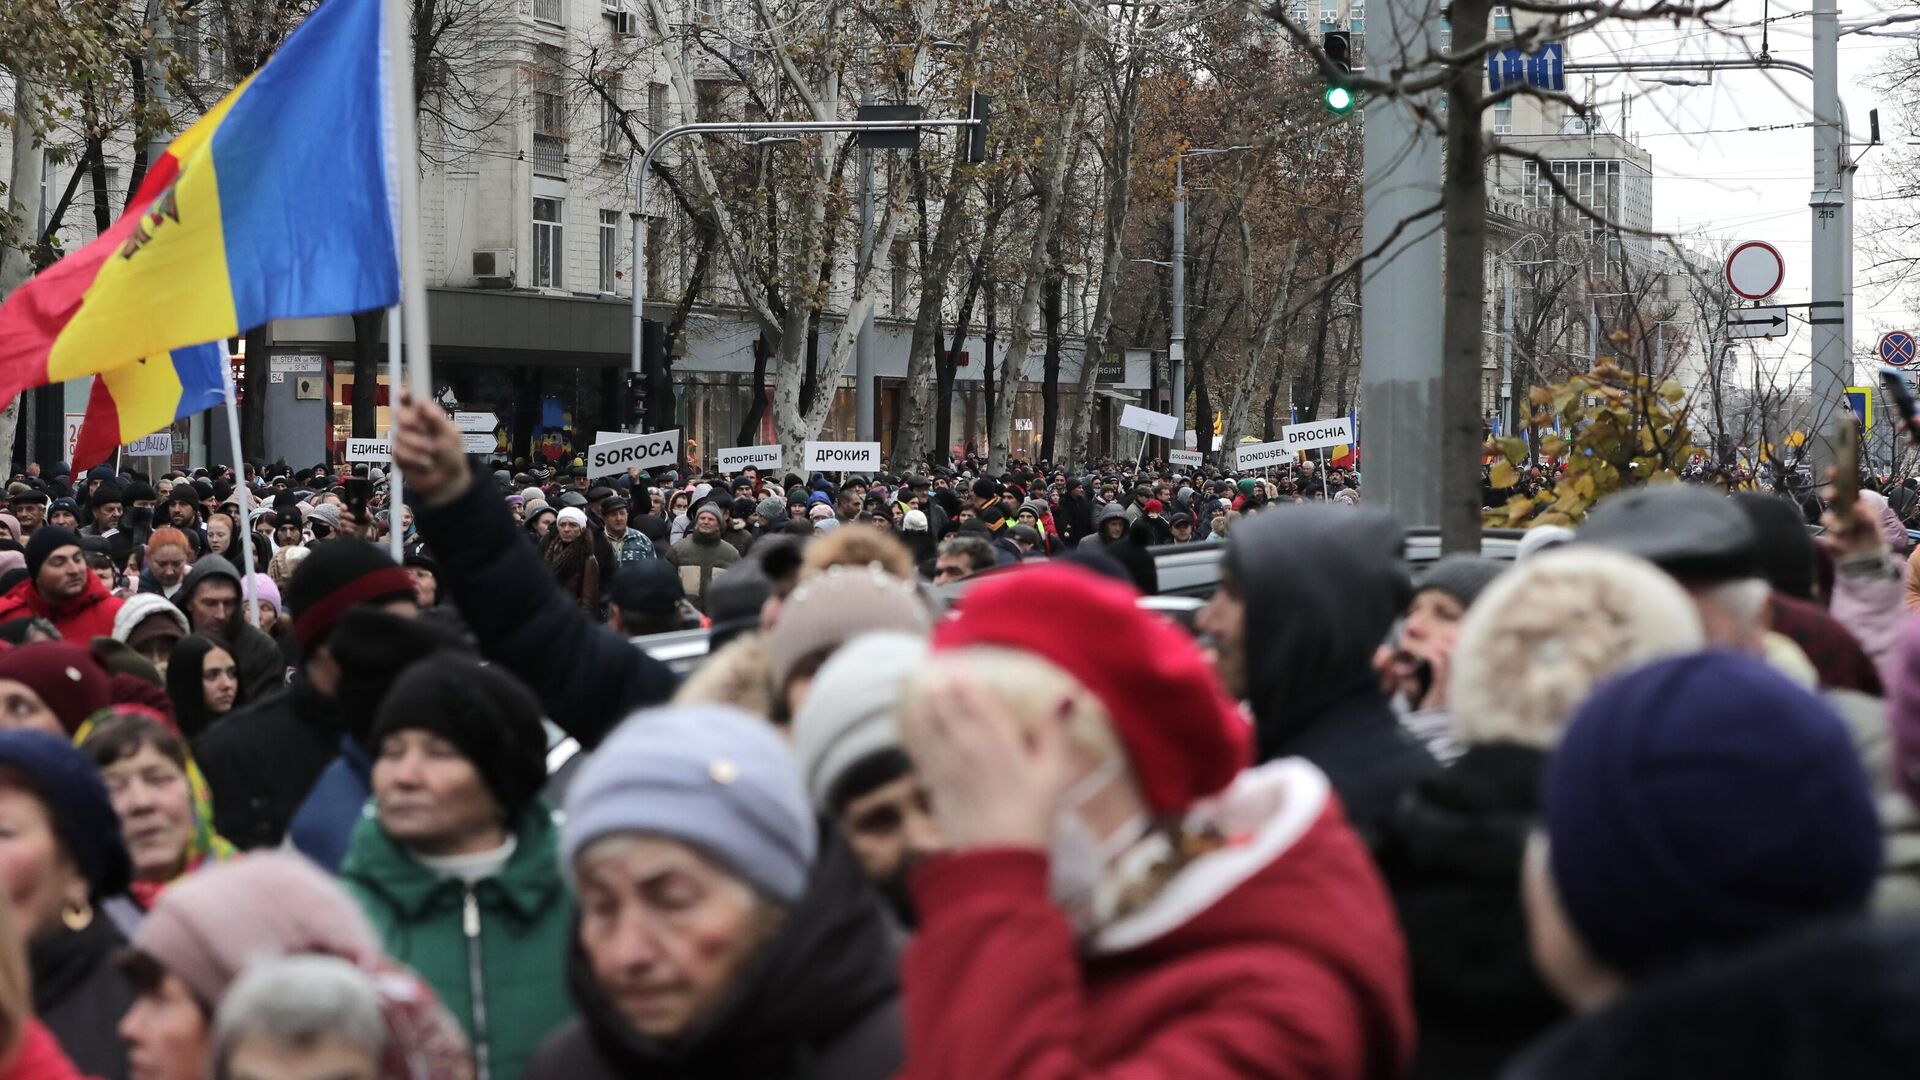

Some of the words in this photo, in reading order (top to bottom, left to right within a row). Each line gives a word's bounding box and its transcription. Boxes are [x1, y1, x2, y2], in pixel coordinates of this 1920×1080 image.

[1818, 210, 1834, 218] 215
[1096, 365, 1121, 375] RGINT
[271, 373, 282, 382] 64
[1289, 426, 1346, 443] DROCHIA
[594, 440, 674, 467] SOROCA
[722, 453, 778, 465] ФЛОРЕШТЫ
[815, 450, 870, 462] ДРОКИЯ
[1240, 448, 1290, 464] DONDUȘEN
